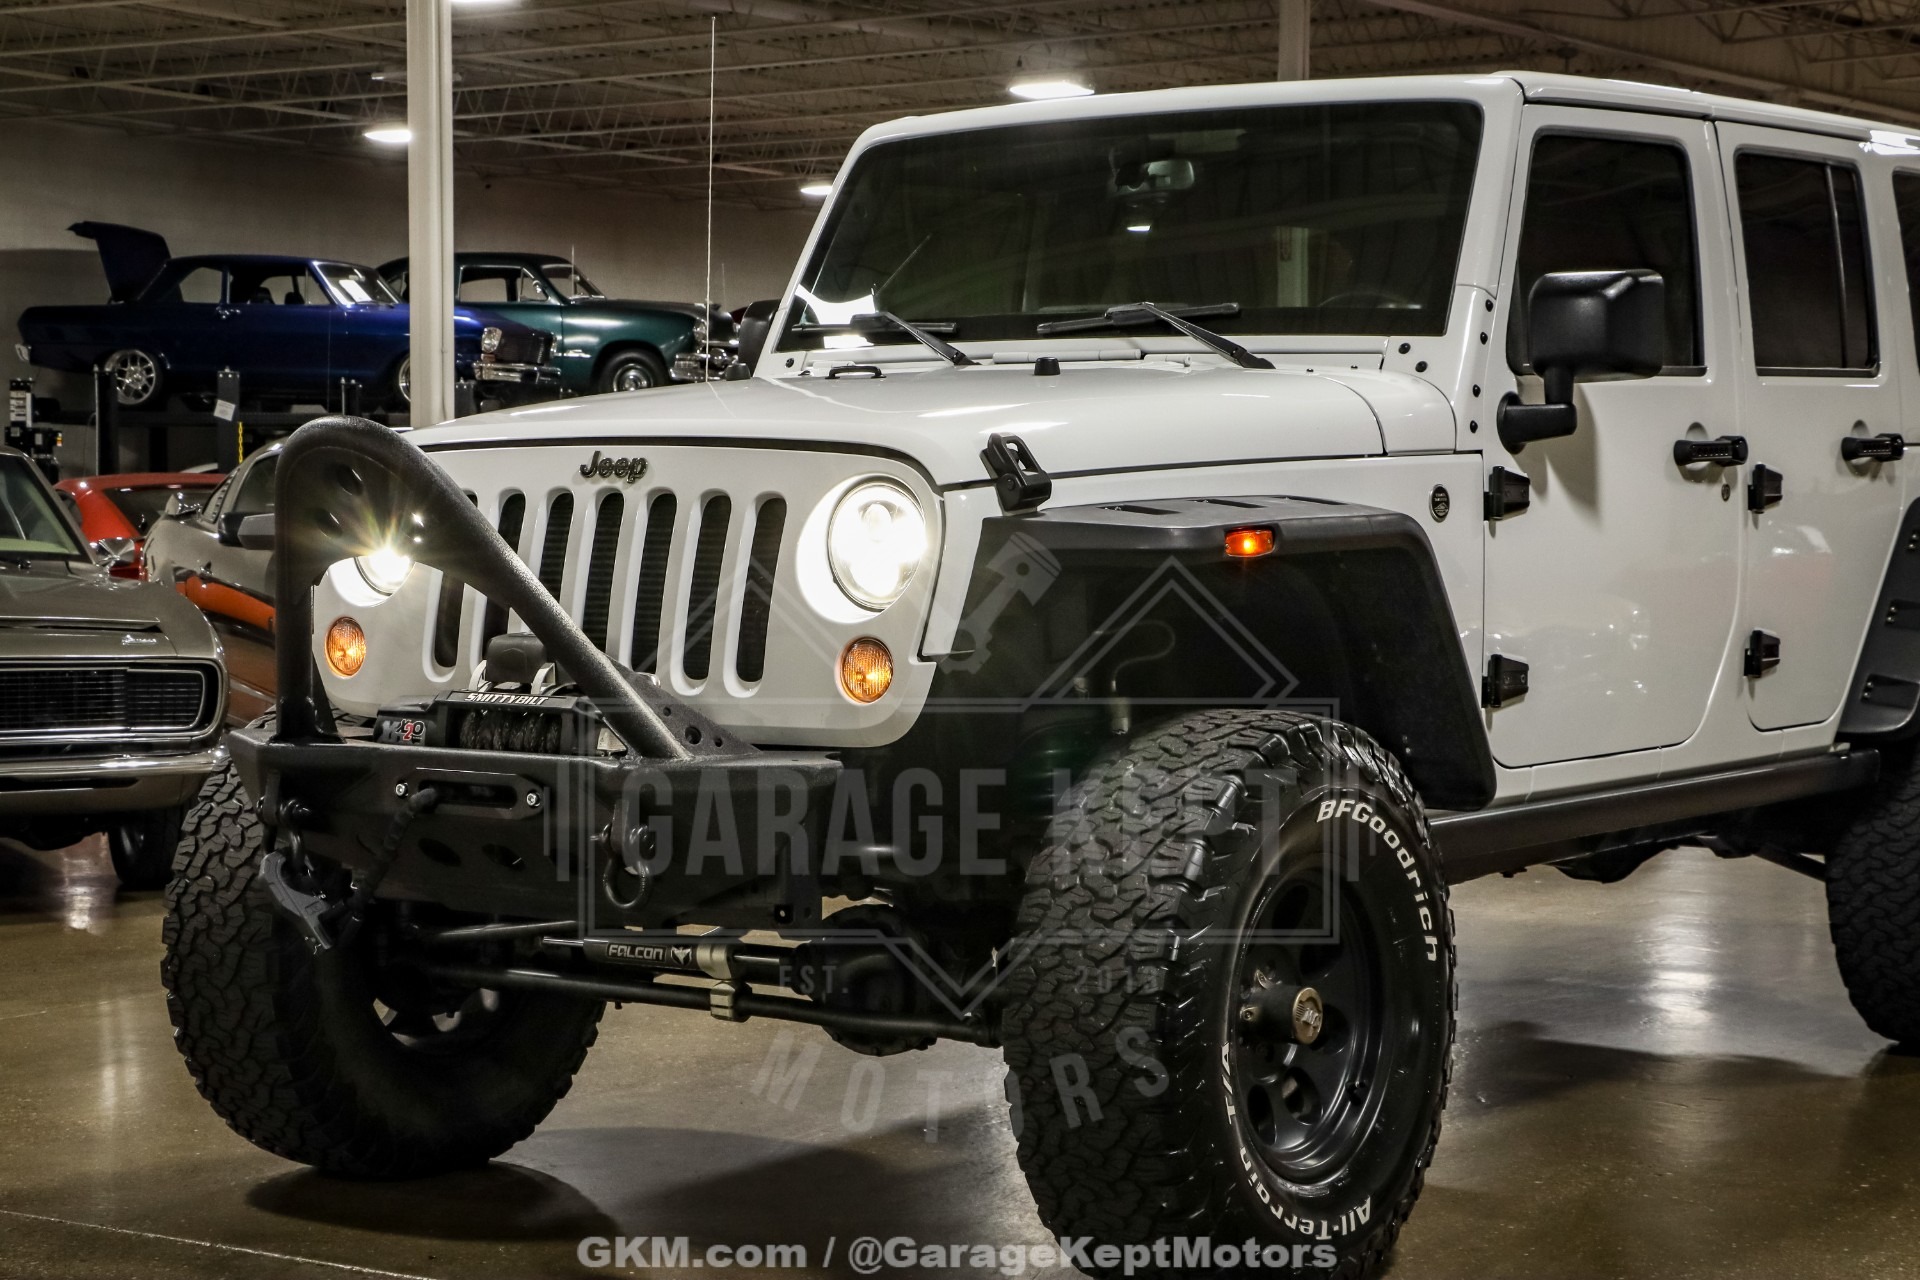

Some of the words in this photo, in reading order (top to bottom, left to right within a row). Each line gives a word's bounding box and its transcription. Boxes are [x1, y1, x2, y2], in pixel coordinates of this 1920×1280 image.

[580, 450, 648, 484] Jeep
[465, 692, 548, 705] SMITTYBILT
[1316, 798, 1437, 962] BFGoodrich
[608, 944, 664, 961] FALCON
[1220, 1042, 1237, 1125] T/A
[1239, 1145, 1371, 1241] All-Terrain
